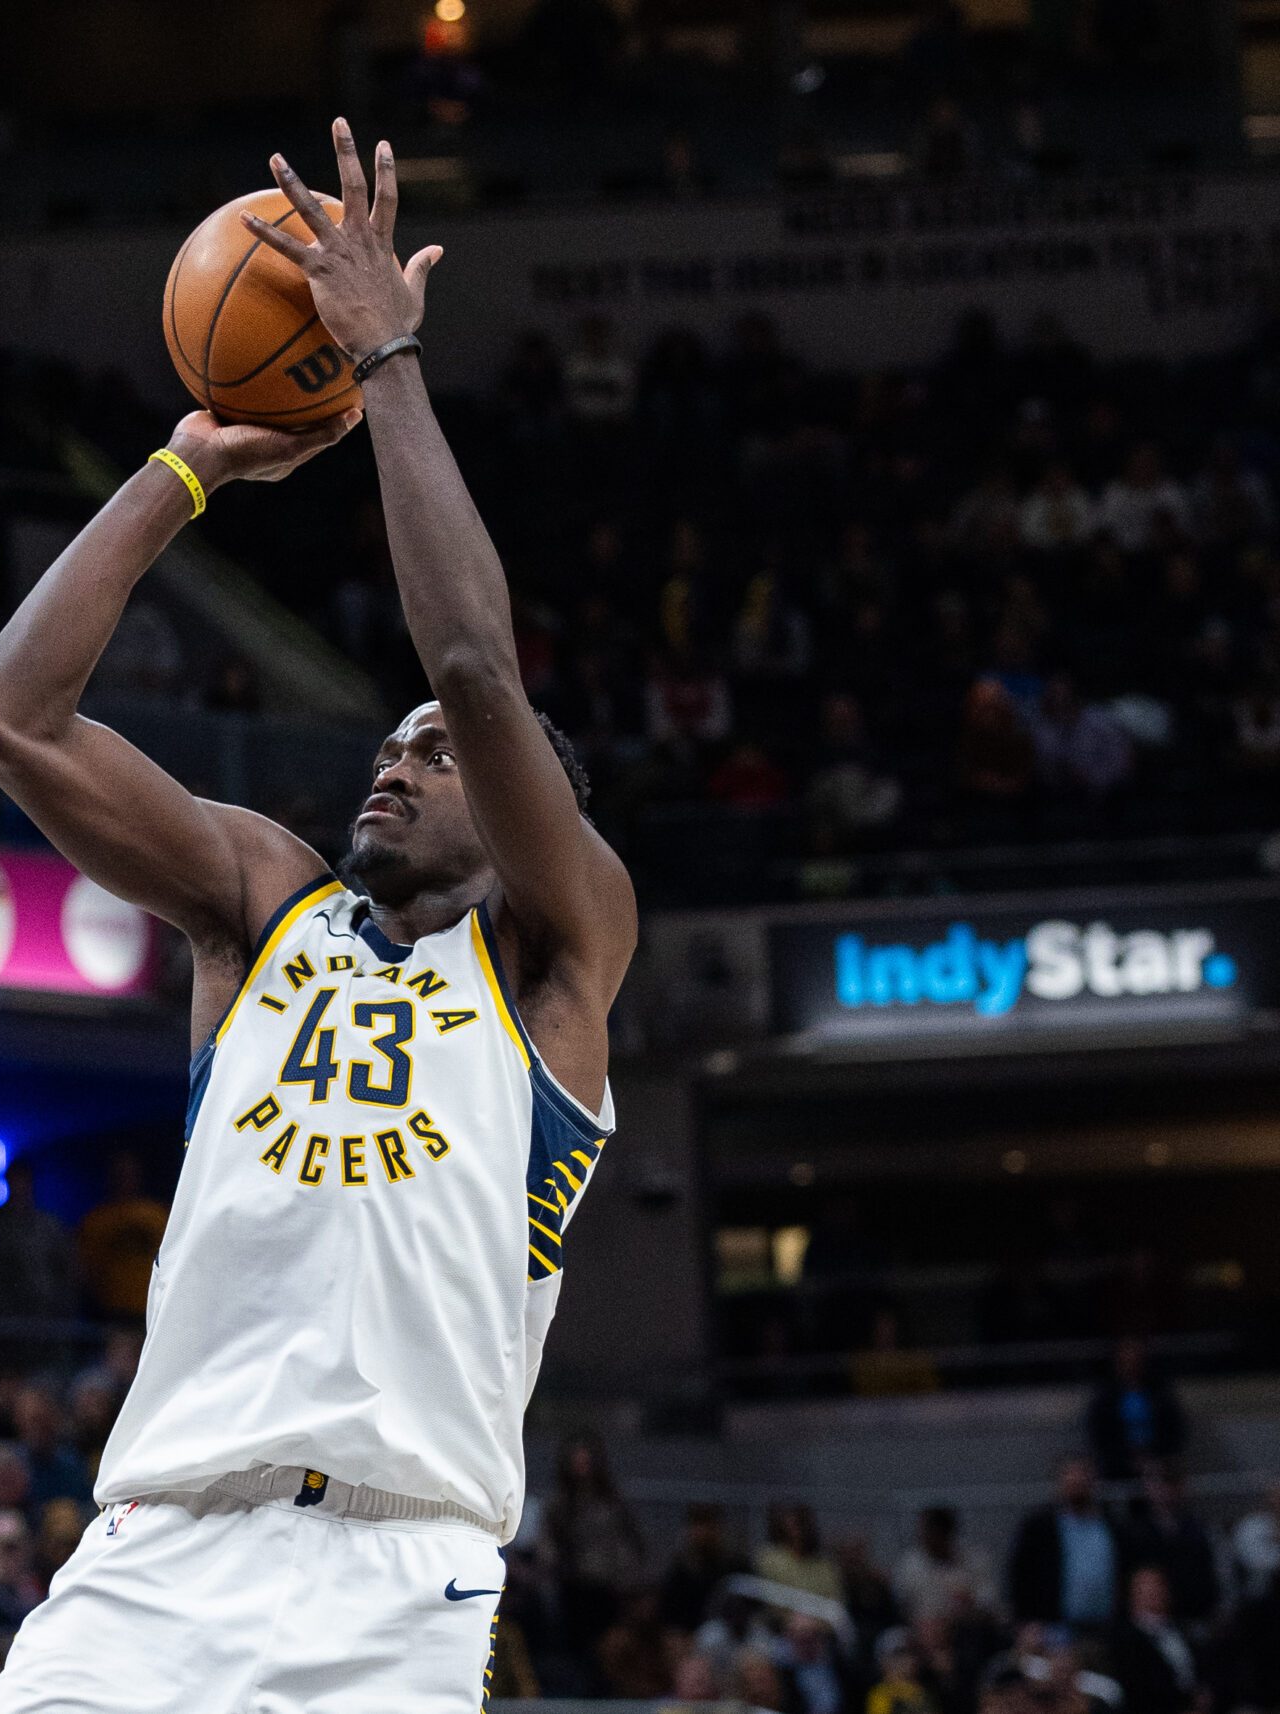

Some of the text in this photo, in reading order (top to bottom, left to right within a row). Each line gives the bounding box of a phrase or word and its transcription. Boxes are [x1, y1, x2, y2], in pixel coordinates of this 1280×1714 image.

[257, 950, 480, 1035] INDANA
[278, 986, 416, 1110] 43
[232, 1091, 451, 1187] PACERS
